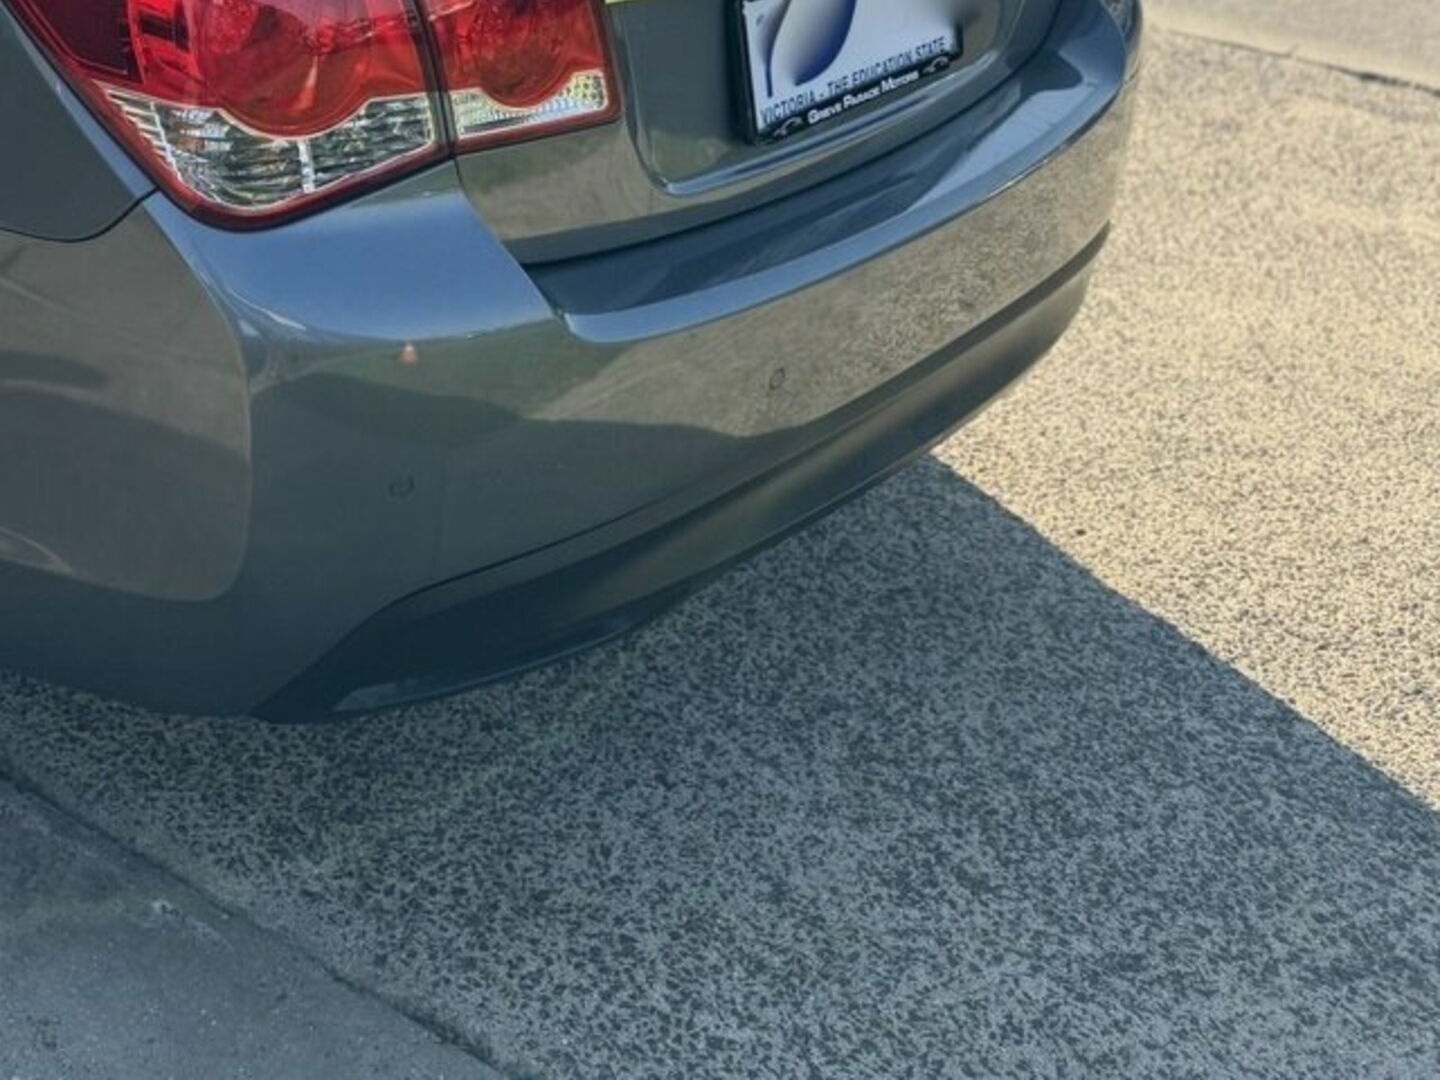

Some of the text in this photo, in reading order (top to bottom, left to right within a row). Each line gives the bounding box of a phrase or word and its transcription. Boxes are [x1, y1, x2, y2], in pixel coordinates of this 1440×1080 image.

[760, 90, 816, 124] VICTORIA
[826, 75, 850, 99] THE
[851, 53, 913, 88] EDUCATION
[914, 36, 947, 63] STATE
